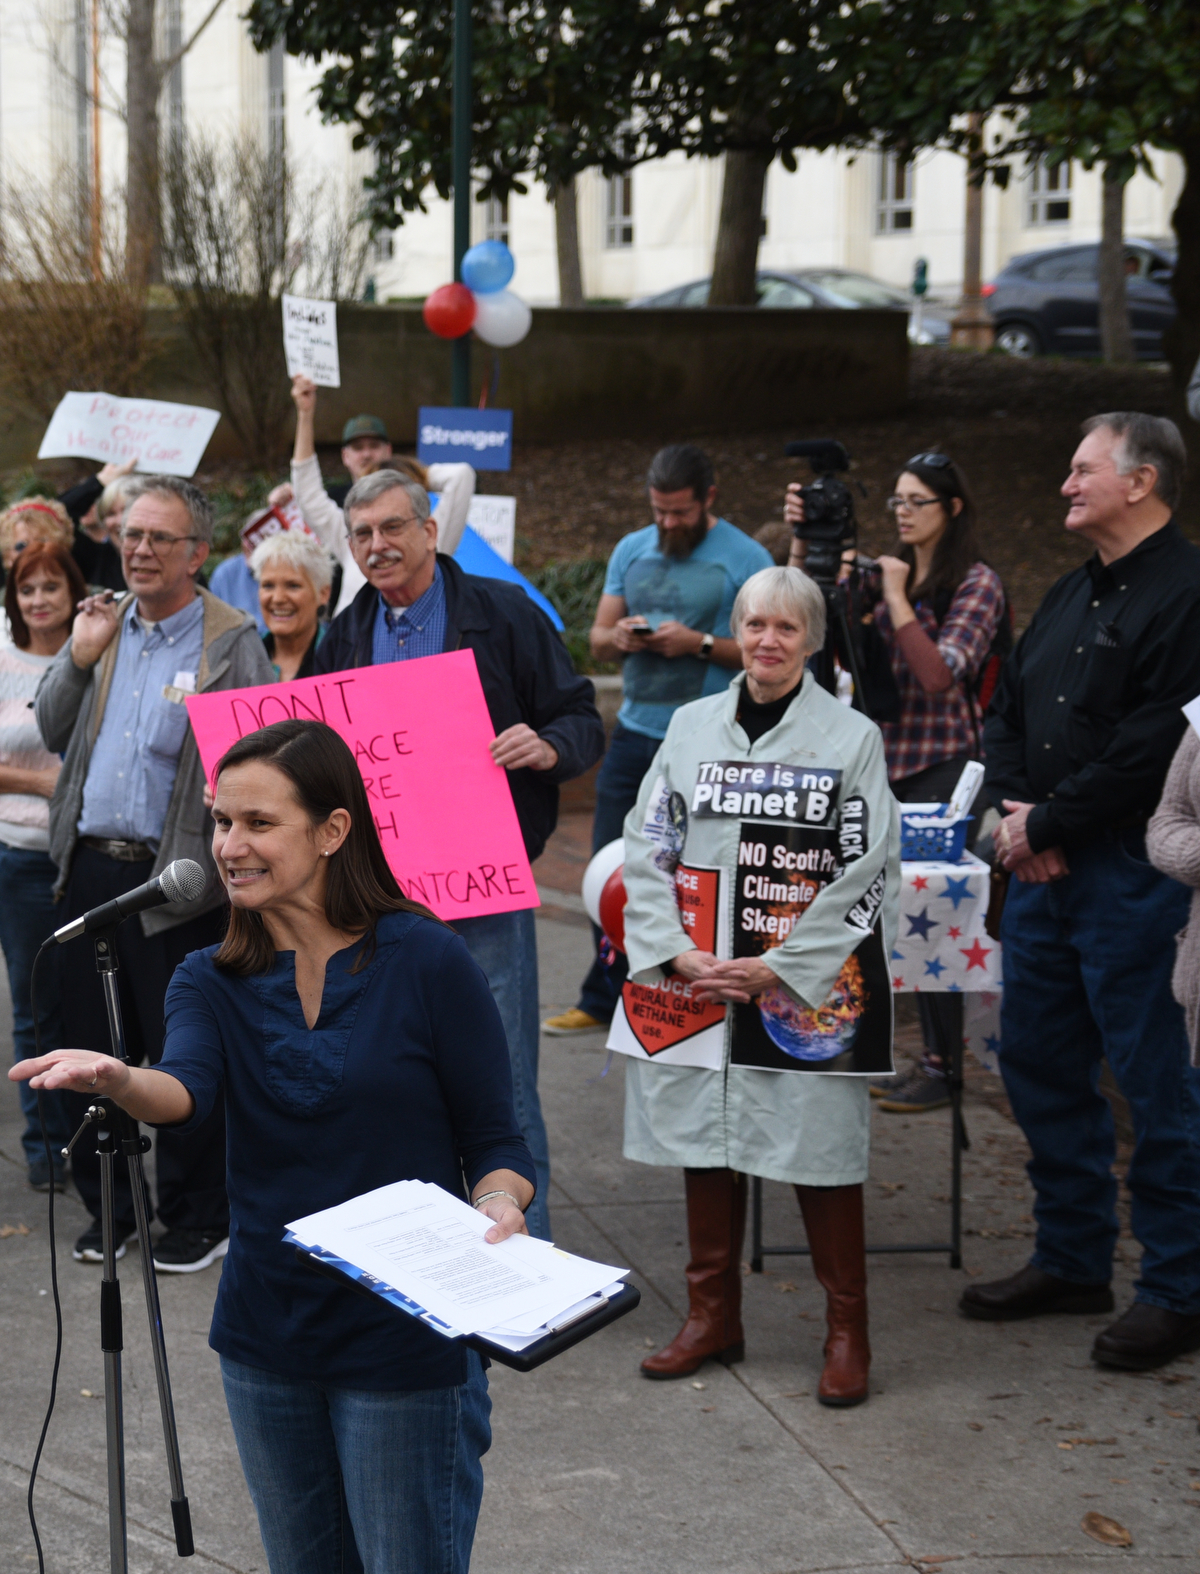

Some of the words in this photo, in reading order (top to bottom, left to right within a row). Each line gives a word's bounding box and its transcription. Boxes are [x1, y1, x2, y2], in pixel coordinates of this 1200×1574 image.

[421, 425, 508, 451] Stronger
[699, 762, 765, 784] There
[772, 764, 795, 787] is
[801, 773, 834, 792] no
[692, 784, 798, 818] Planet
[805, 791, 830, 822] B
[838, 800, 863, 859] BLACK
[739, 841, 767, 867] NO
[771, 844, 820, 871] Scott
[743, 875, 814, 903] Climate
[642, 1024, 665, 1040] use.
